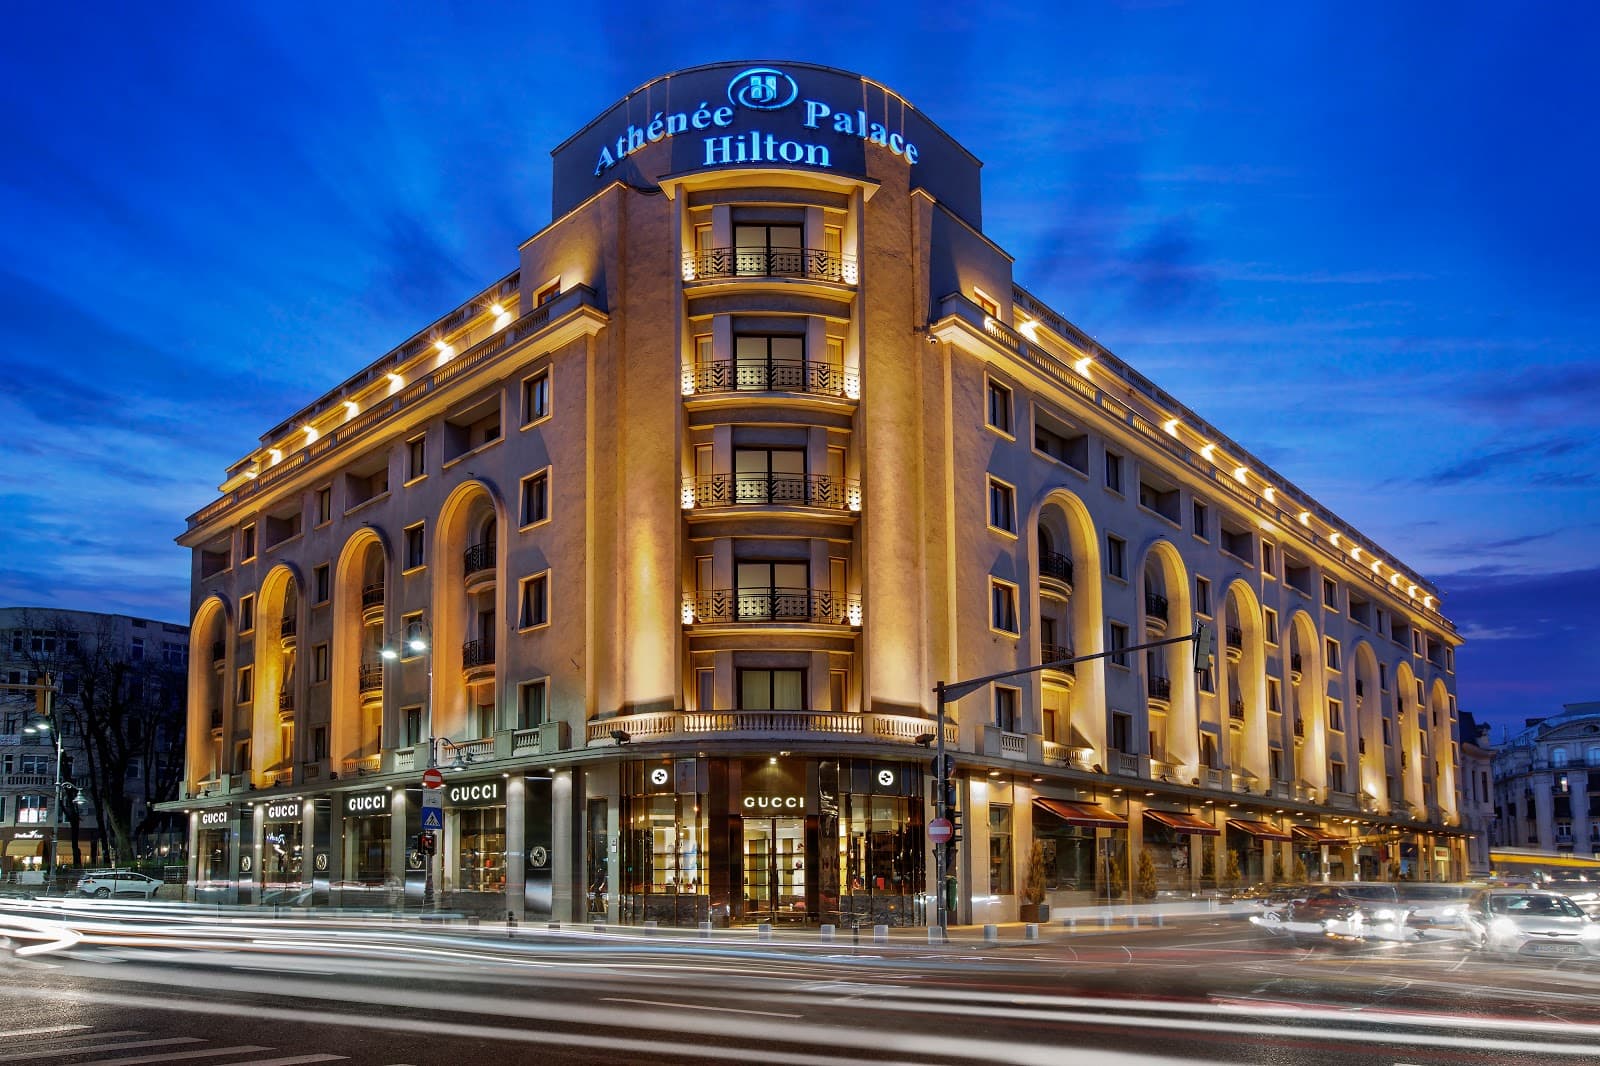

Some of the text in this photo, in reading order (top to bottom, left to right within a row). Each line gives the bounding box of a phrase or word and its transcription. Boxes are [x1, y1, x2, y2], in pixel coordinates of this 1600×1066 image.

[593, 99, 920, 176] Athénée Palace
[702, 131, 832, 168] Hilton
[450, 783, 498, 801] GUCCI
[348, 795, 386, 811] GUCCI
[743, 796, 805, 808] GUCCI
[202, 811, 228, 825] GUCCI
[268, 804, 299, 818] GUCCI
